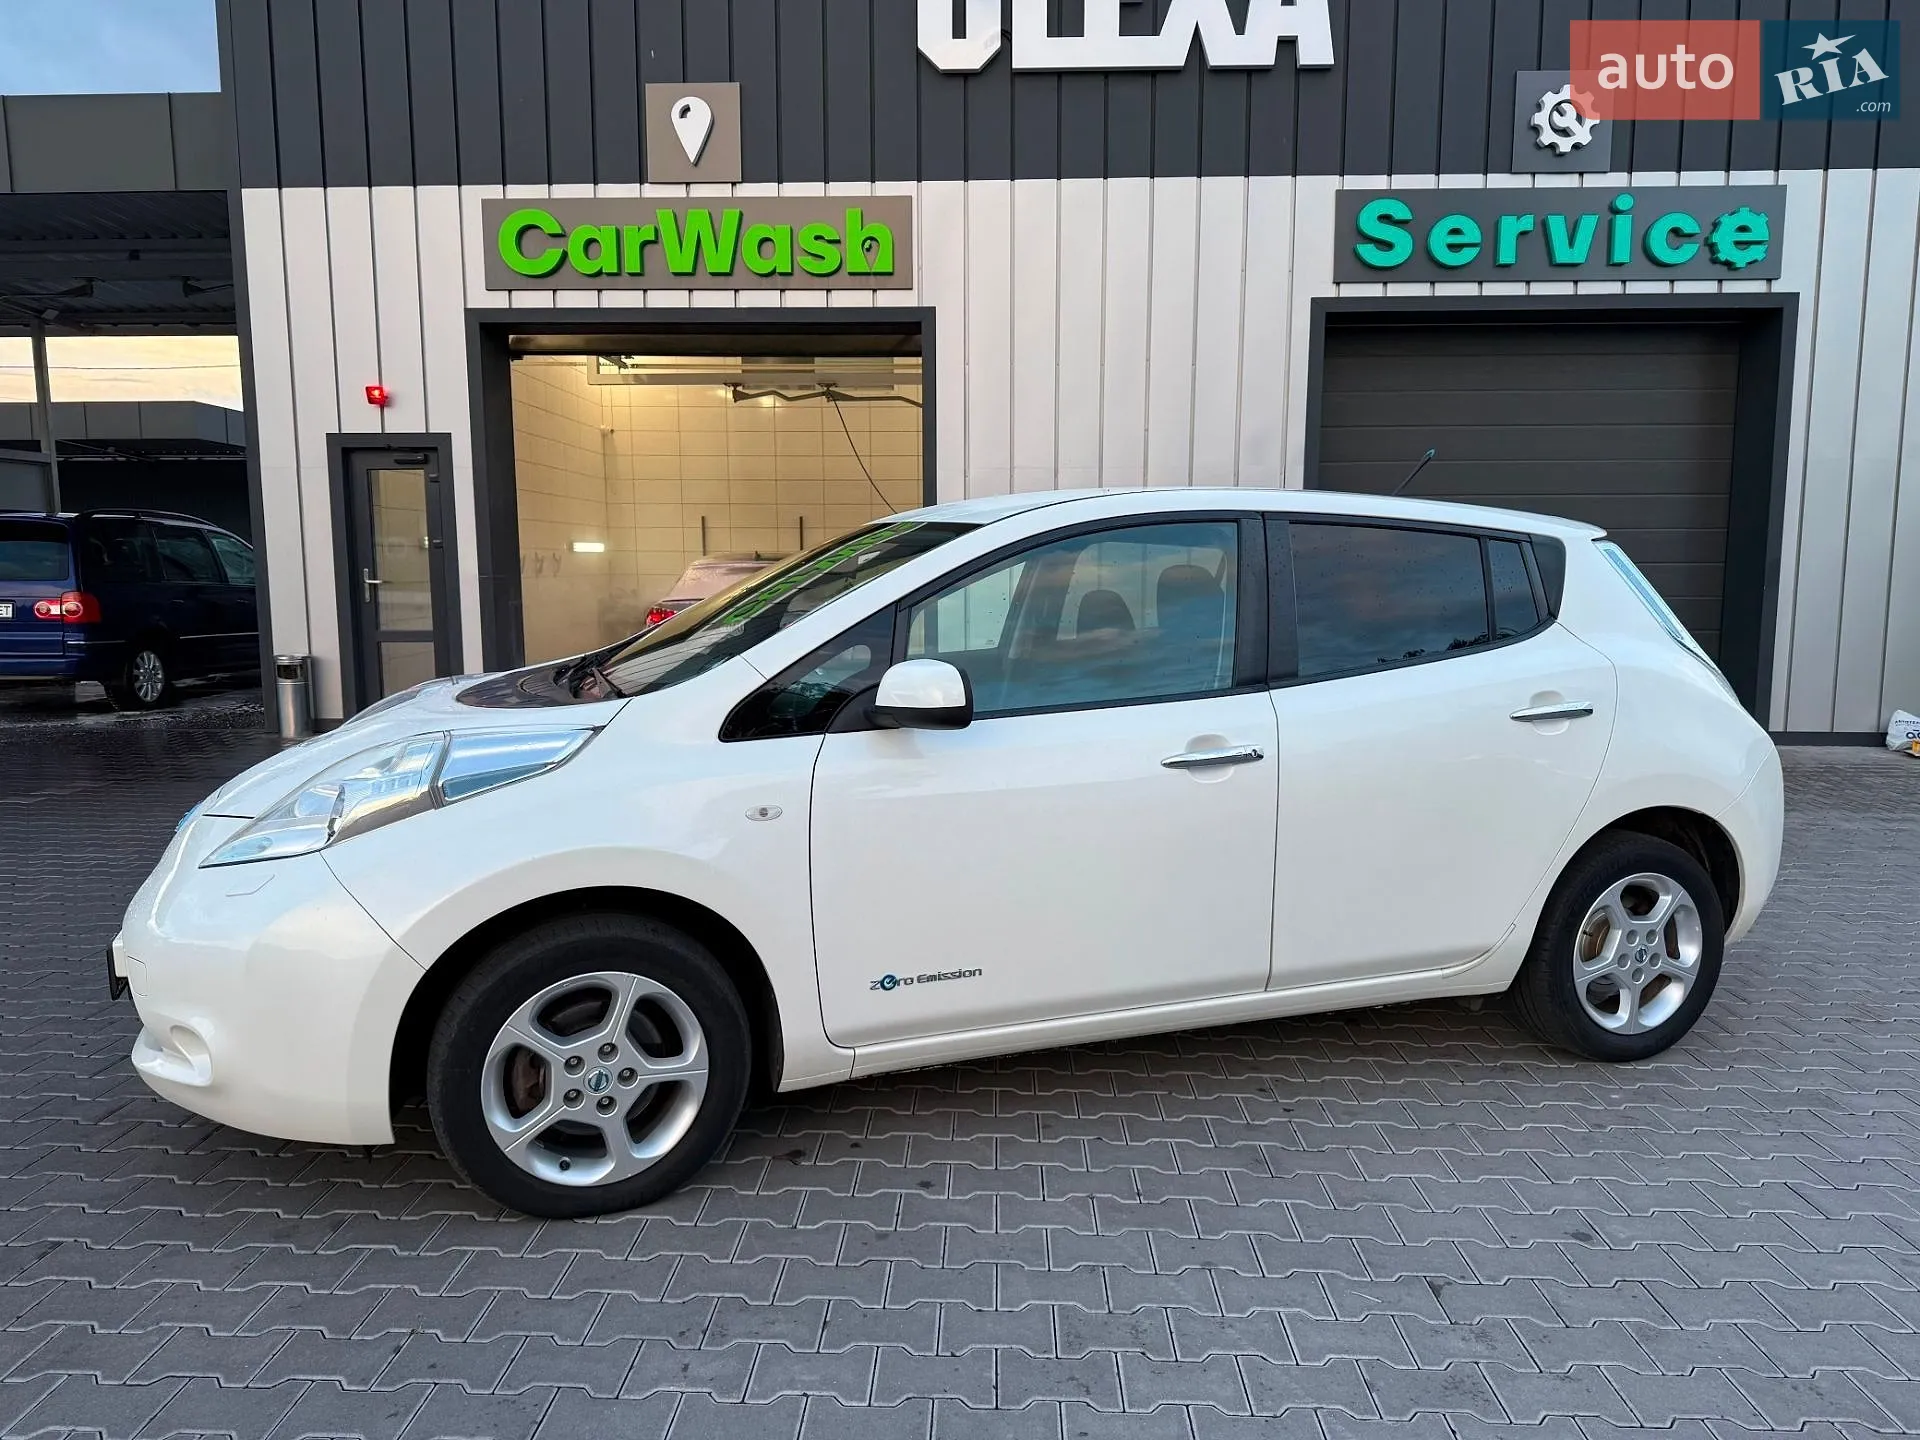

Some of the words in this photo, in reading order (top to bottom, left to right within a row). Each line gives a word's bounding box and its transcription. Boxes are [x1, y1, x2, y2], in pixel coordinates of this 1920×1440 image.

[498, 207, 895, 278] CarWash
[1353, 193, 1770, 270] Service
[916, 967, 983, 984] Emission
